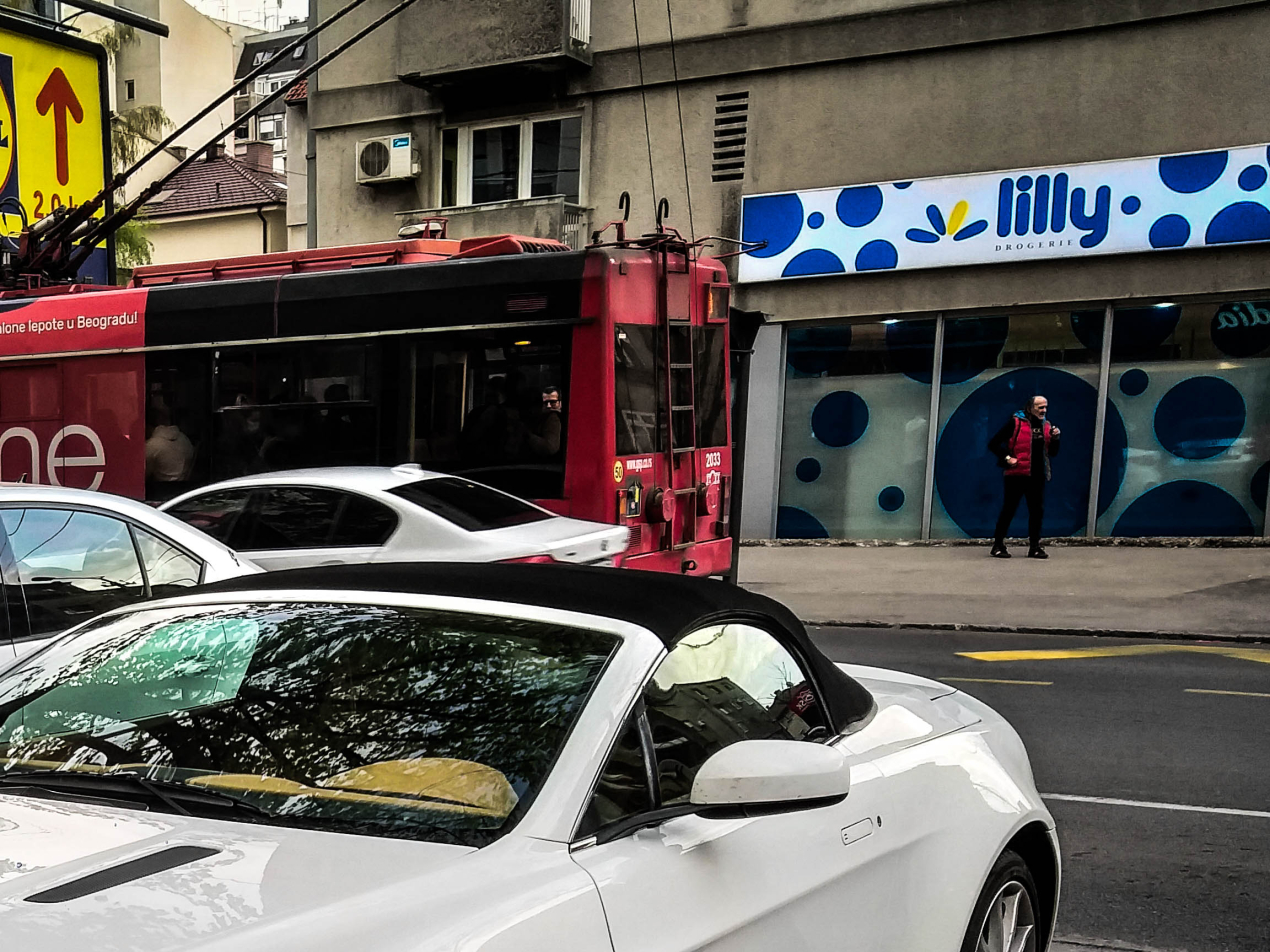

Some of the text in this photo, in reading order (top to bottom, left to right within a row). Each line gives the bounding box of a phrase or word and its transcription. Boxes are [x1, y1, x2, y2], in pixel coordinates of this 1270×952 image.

[997, 172, 1112, 248] lilly
[995, 239, 1073, 251] DROGERIE
[28, 318, 64, 334] lepote
[67, 317, 74, 329] u
[77, 311, 138, 330] Beogradu!
[705, 452, 721, 468] 2033
[615, 466, 623, 479] 50
